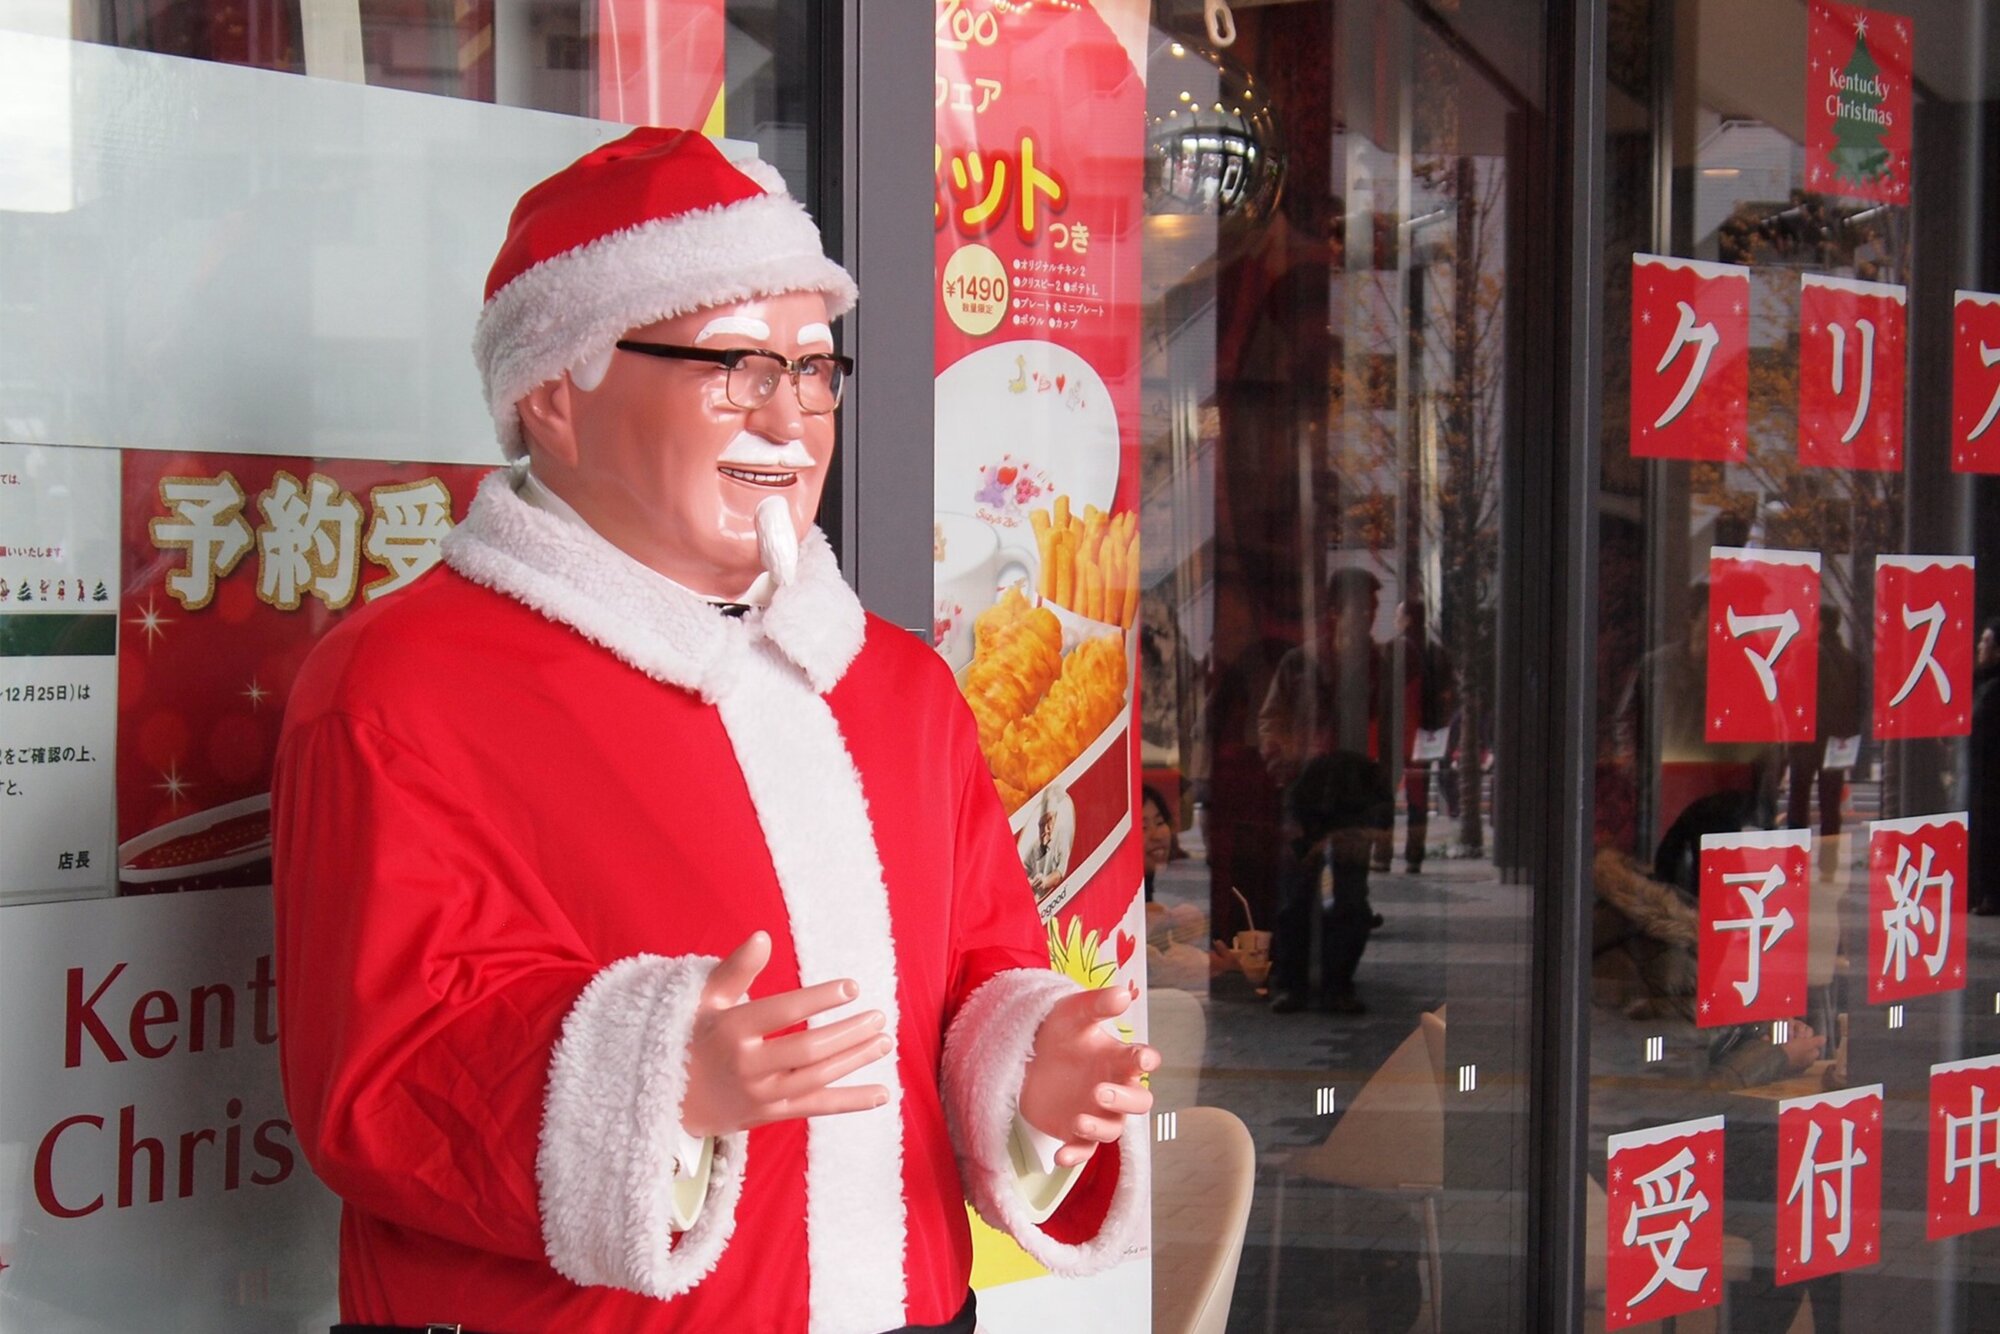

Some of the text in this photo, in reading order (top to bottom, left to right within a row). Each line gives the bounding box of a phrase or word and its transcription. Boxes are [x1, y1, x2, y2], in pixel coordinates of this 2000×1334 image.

[1829, 67, 1890, 102] Kentucky
[1826, 94, 1893, 126] Christmas
[935, 137, 1061, 231] ット
[1048, 221, 1089, 254] つき
[1020, 259, 1086, 277] オリジナルチキン2
[945, 275, 1005, 302] ¥1490
[0, 684, 90, 702] 12月25日)は
[0, 745, 97, 766] をご確認の上、
[58, 850, 90, 871] 店長
[65, 954, 279, 1069] Kent
[34, 1098, 294, 1219] Chris
